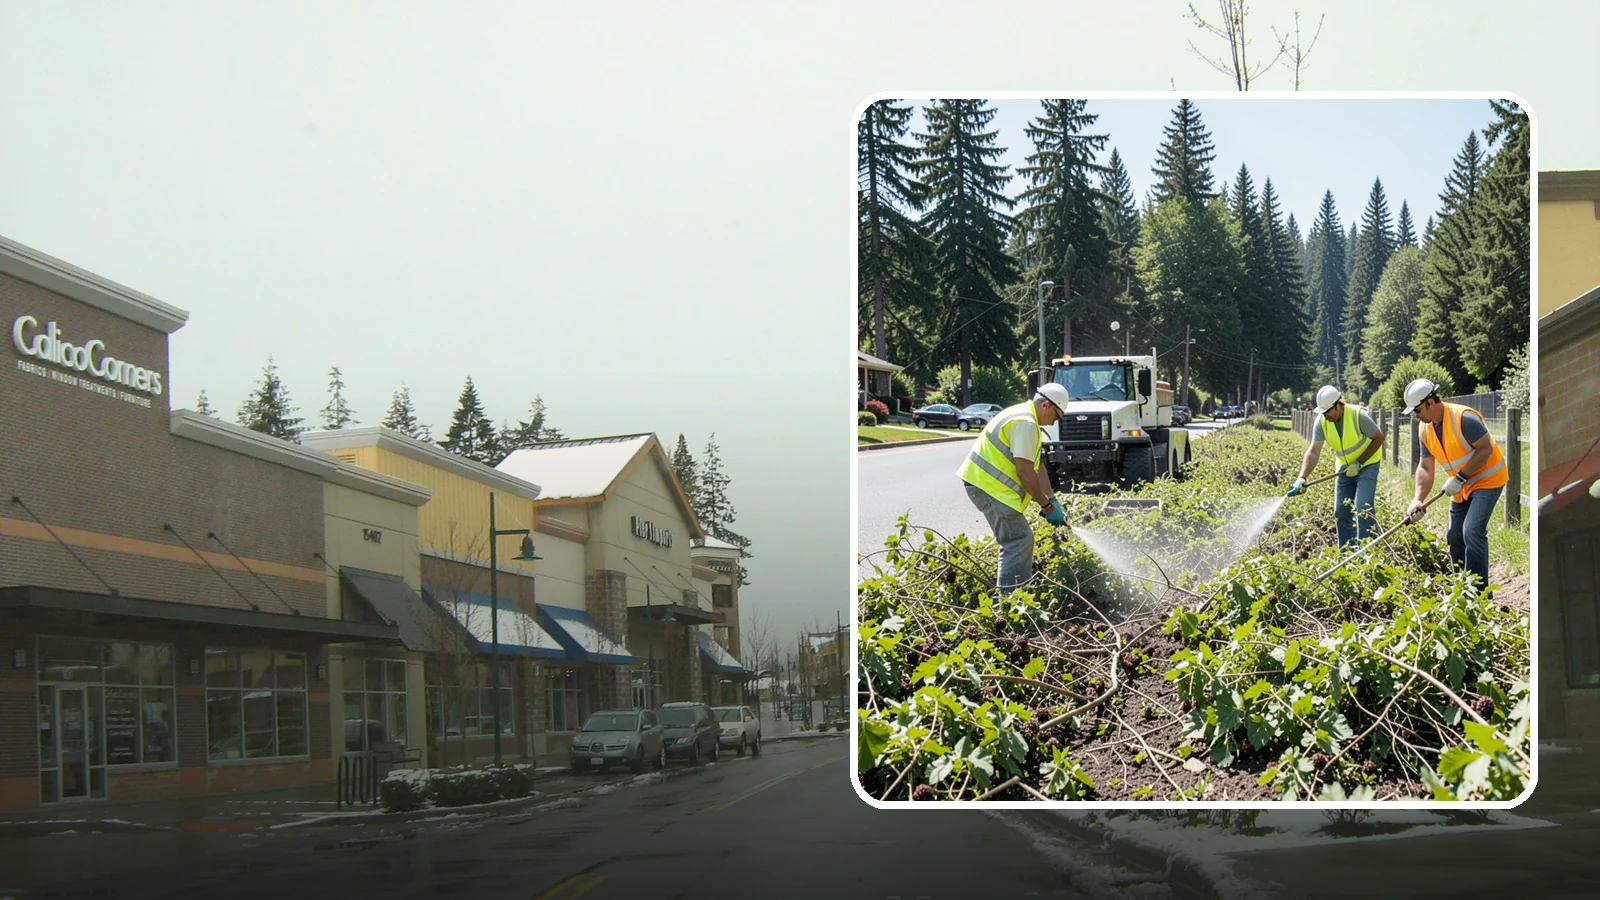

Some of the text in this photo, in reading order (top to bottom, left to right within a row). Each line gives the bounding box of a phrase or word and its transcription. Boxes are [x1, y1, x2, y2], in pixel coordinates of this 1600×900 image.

[17, 360, 151, 408] FABRICS WINDOW TREATMENTS FURNITURE
